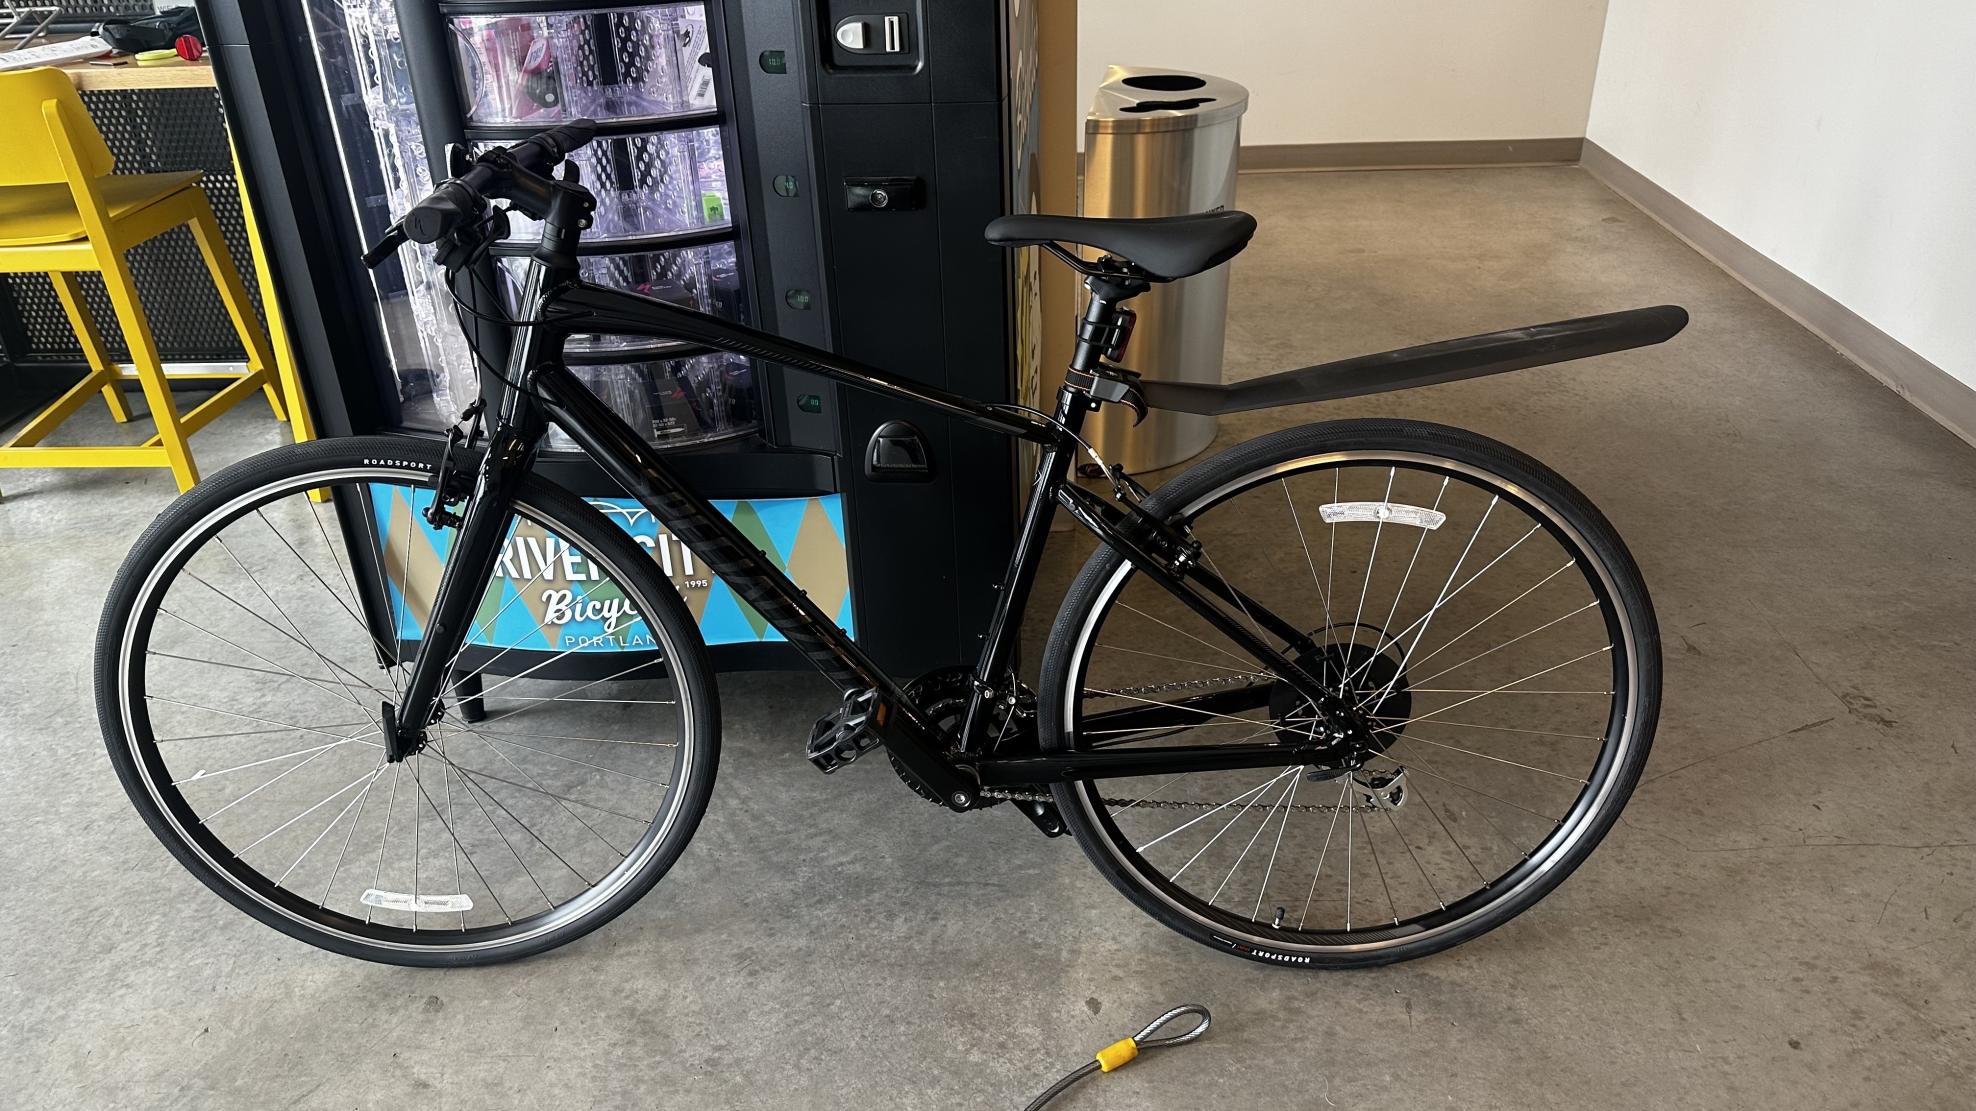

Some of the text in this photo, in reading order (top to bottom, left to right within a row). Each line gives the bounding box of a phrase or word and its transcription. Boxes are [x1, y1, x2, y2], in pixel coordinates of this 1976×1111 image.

[363, 458, 433, 470] ROADSPORT
[494, 536, 600, 581] RIVE
[684, 579, 708, 589] 1995
[565, 634, 657, 647] PORTLAN
[1251, 948, 1311, 964] ROADSPORT
